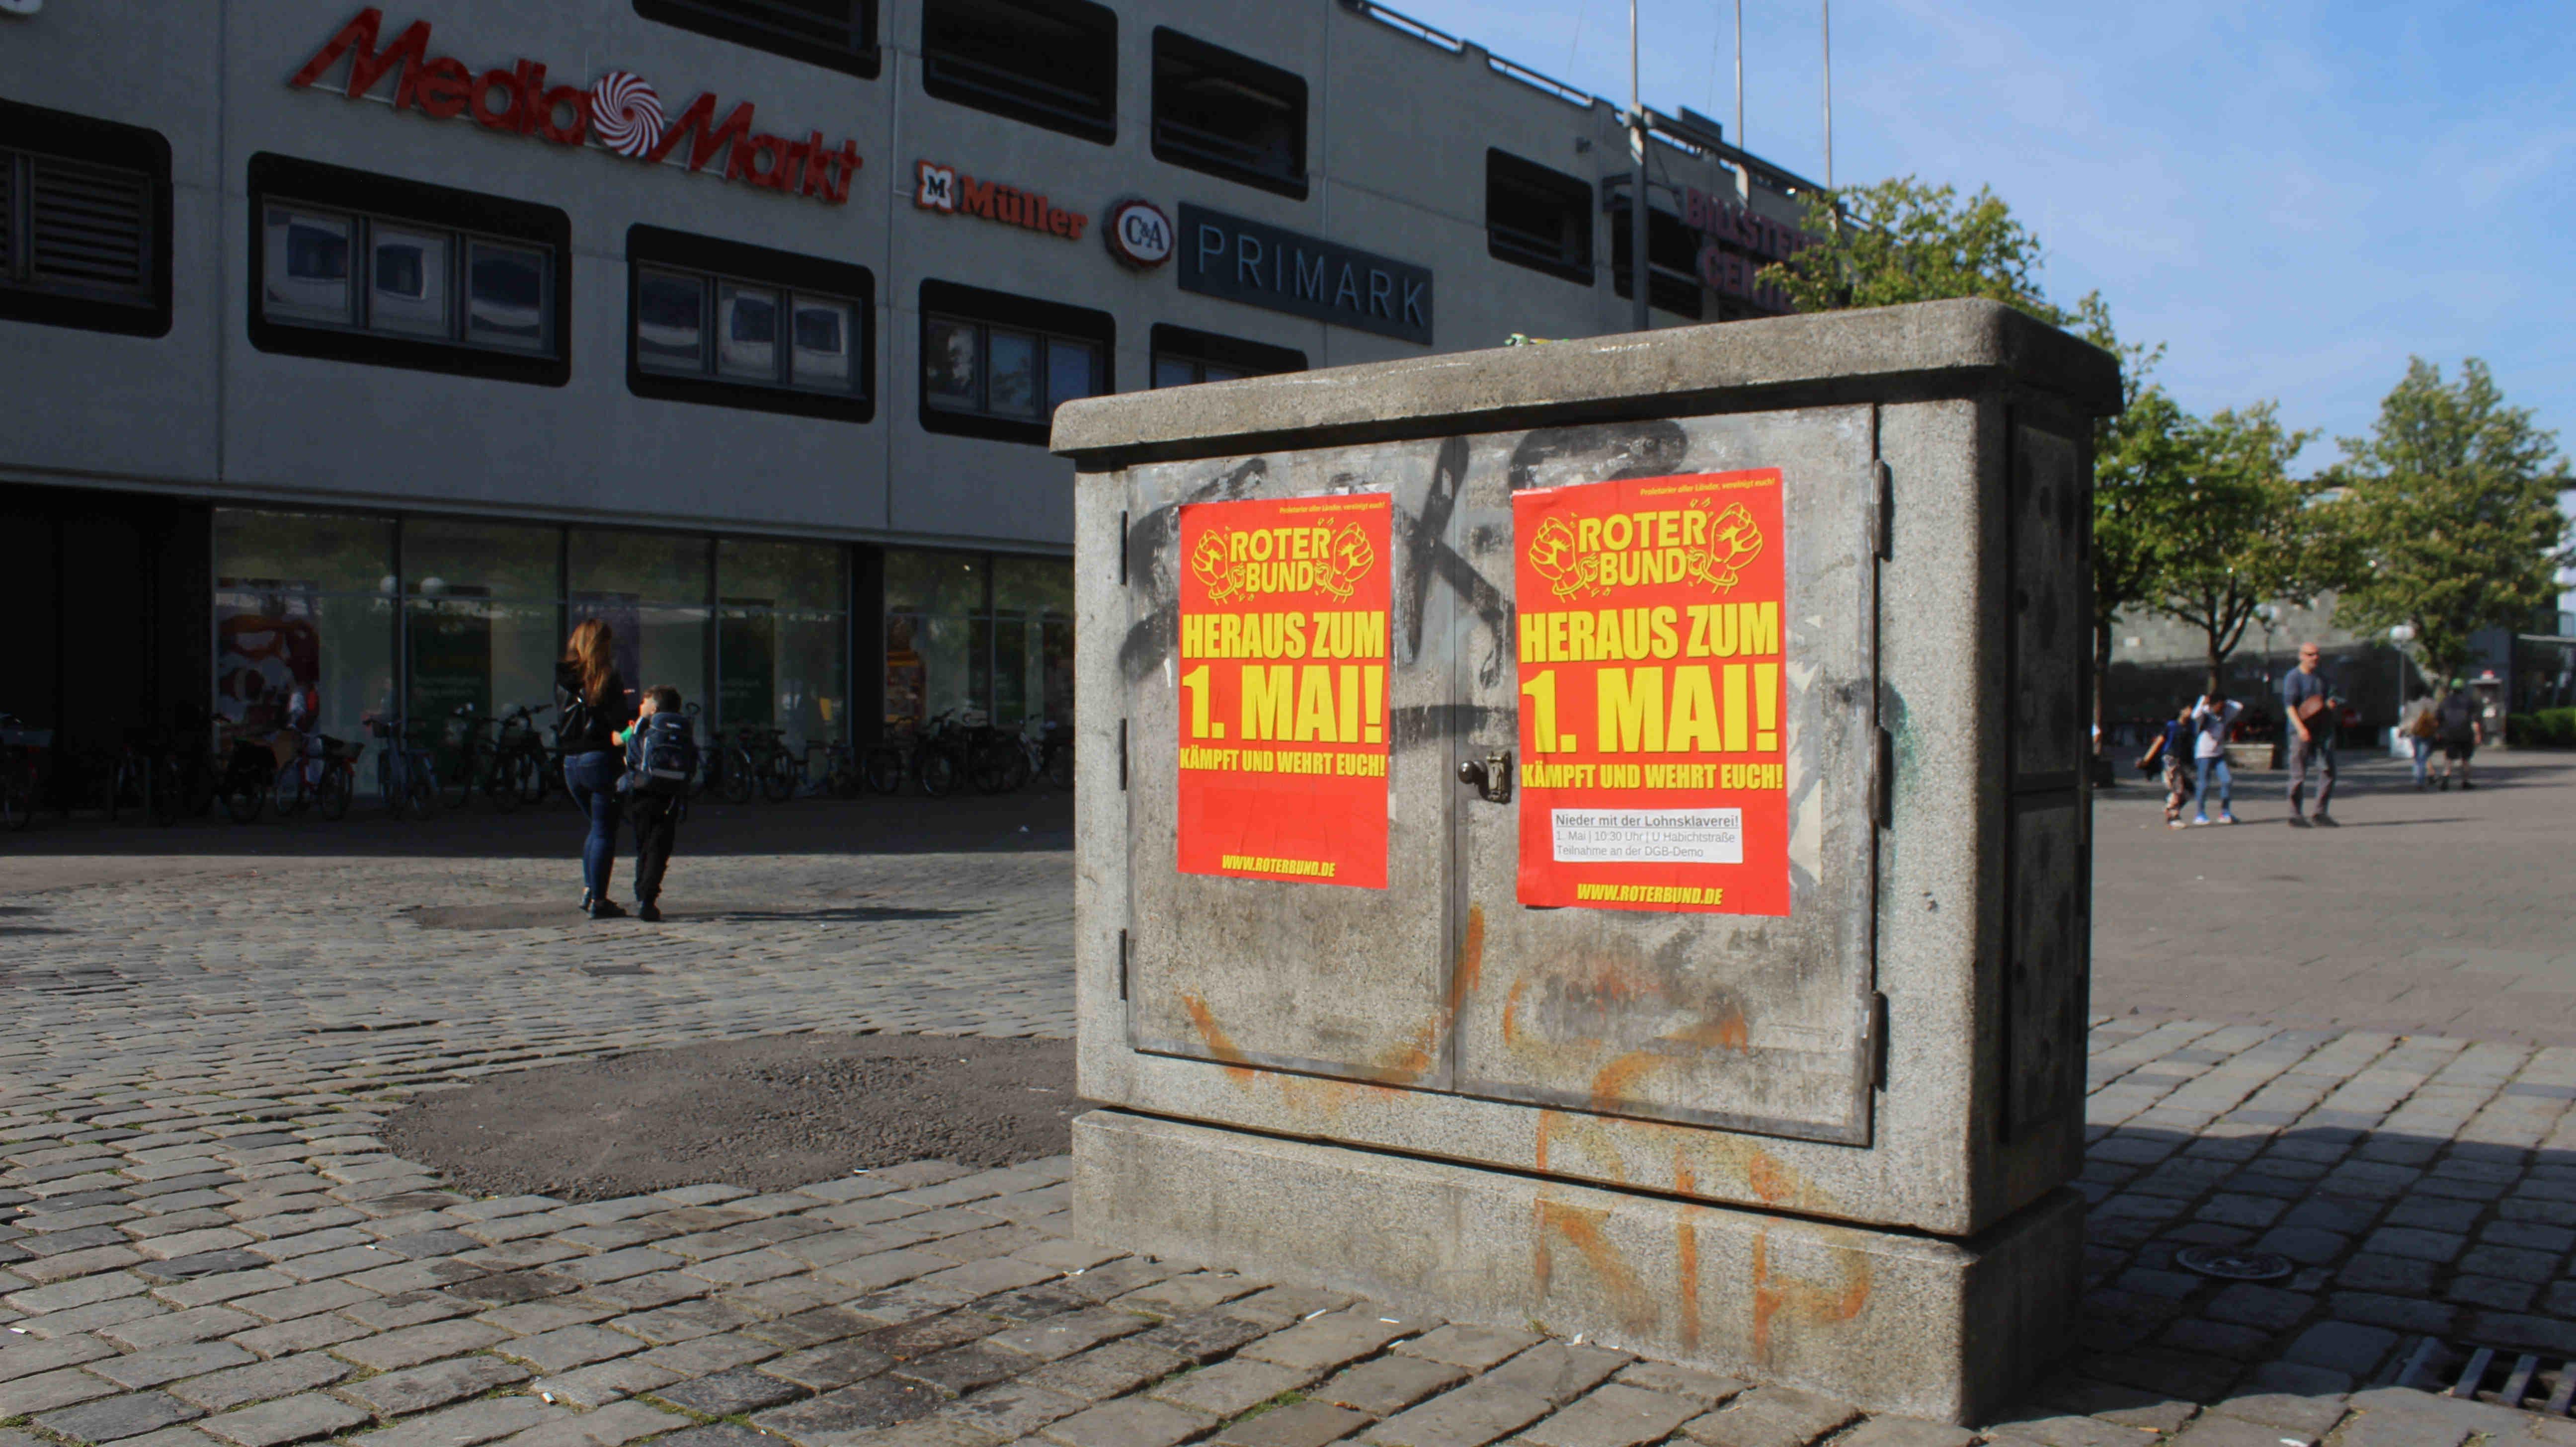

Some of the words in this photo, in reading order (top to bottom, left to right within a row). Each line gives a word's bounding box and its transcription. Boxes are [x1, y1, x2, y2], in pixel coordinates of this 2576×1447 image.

[289, 7, 592, 146] Media
[647, 91, 863, 204] Markt
[927, 175, 946, 199] M
[960, 176, 1088, 240] Müller
[1125, 215, 1164, 251] C&A
[1198, 223, 1424, 326] PRIMARK
[1230, 527, 1332, 563] ROTER
[1579, 510, 1707, 553] ROTER
[1245, 561, 1313, 593] BUND
[1600, 548, 1688, 586] BUND
[1182, 611, 1306, 659] HERAUS
[1312, 611, 1385, 659] ZUM
[1520, 606, 1679, 663] HERAUS
[1687, 601, 1778, 658] ZUM
[1182, 665, 1225, 739] 1.
[1241, 665, 1384, 743] MAI!
[1522, 670, 1577, 753] 1.
[1597, 663, 1778, 753] MAI!
[1179, 744, 1239, 771] KÄMPFT
[1242, 750, 1274, 772] UND
[1276, 751, 1335, 775] WEHRT
[1336, 753, 1385, 777] EUCH!
[1521, 759, 1596, 789] KÄMPFT
[1600, 764, 1640, 789] UND
[1644, 764, 1716, 789] WEHRT
[1721, 763, 1783, 790] EUCH!
[1556, 814, 1595, 826] Nieder
[1599, 815, 1617, 826] mit
[1621, 815, 1641, 826] der
[1645, 815, 1739, 827] Lohnsklaverei!
[1568, 831, 1586, 840] Mai
[1595, 831, 1622, 841] 10:30
[1625, 831, 1643, 841] Uhr
[1652, 832, 1660, 842] U
[1663, 831, 1735, 843] Habichtstraße
[1222, 854, 1336, 877] WWW.ROTERBUND.DE
[1557, 845, 1607, 855] Teilnahme
[1625, 846, 1642, 856] der
[1645, 846, 1704, 857] DGB-Demo
[1577, 883, 1724, 905] WWW.ROTERBUND.DE
